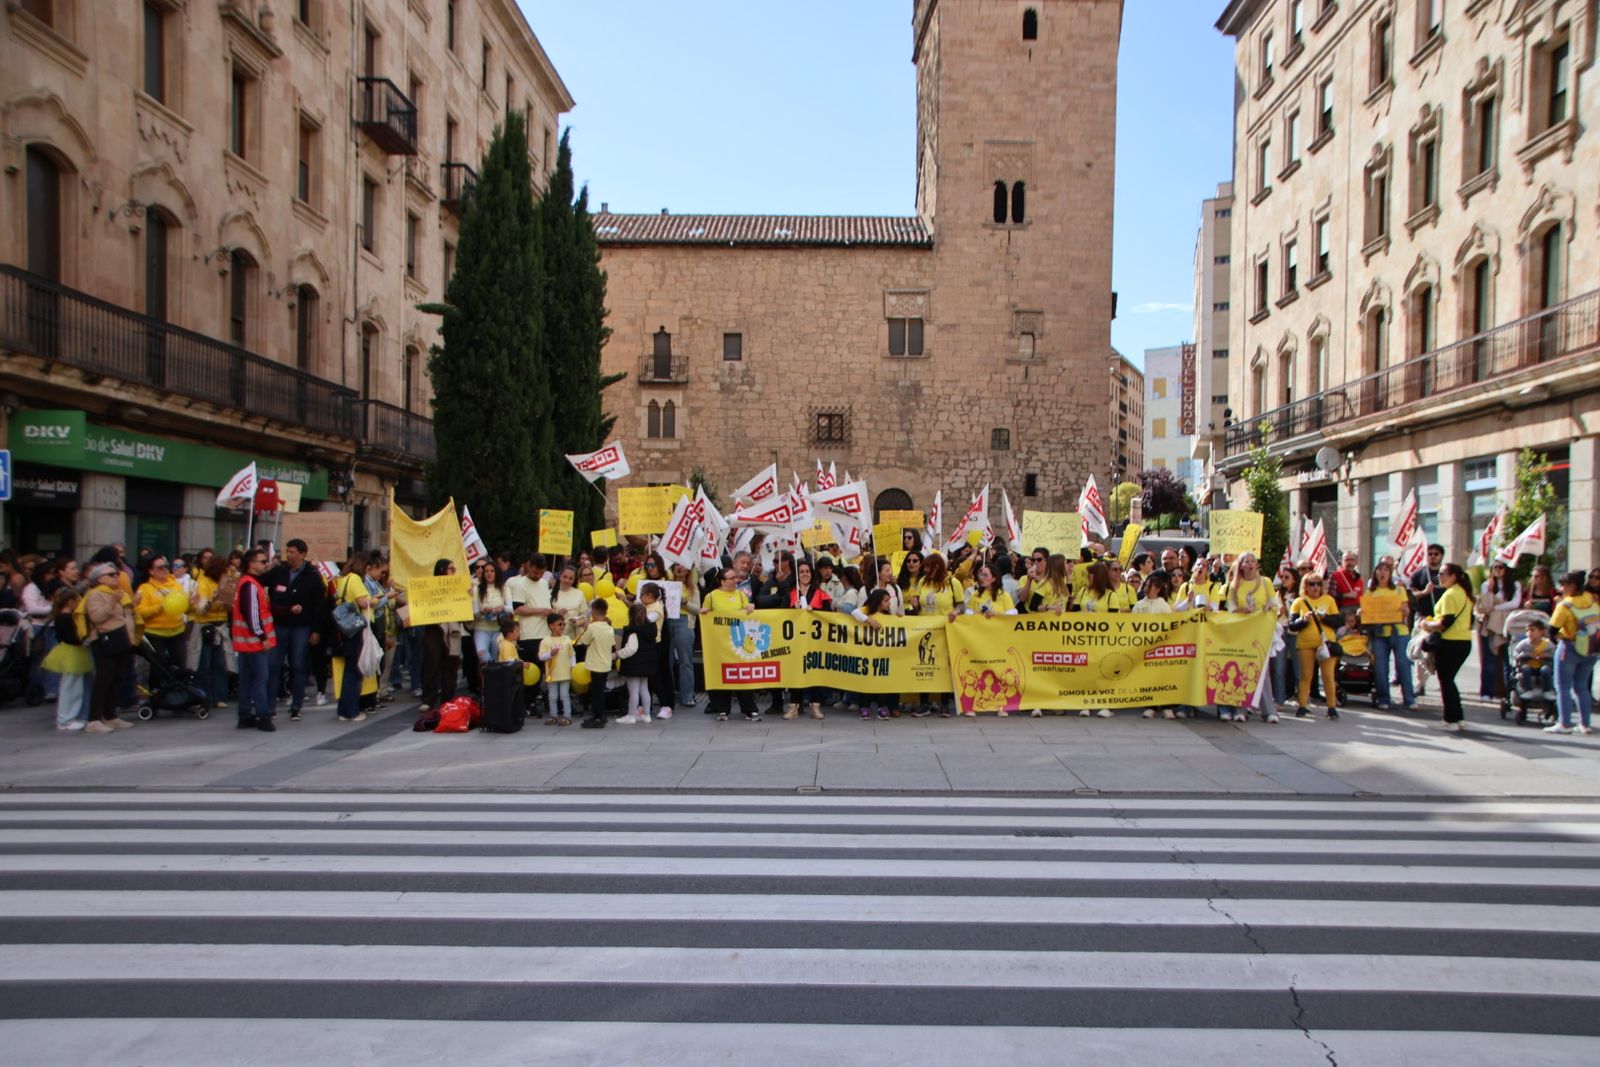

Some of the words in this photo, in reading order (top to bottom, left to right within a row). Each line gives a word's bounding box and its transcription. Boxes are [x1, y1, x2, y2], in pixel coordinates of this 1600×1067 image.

[24, 425, 71, 438] DKV
[111, 438, 135, 457] Salud
[136, 443, 165, 461] DKV
[57, 480, 78, 493] DKV
[669, 504, 698, 552] CCOO
[714, 617, 740, 626] MALTRATO
[1014, 621, 1109, 632] ABANDONO
[1116, 622, 1125, 632] Y
[782, 619, 794, 640] 0
[811, 619, 822, 640] 3
[828, 624, 848, 643] EN
[854, 626, 907, 647] LUCHA
[761, 646, 791, 660] SOLUCIONES
[1146, 646, 1184, 658] CCOO
[803, 651, 869, 676] ¡SOLUCIONES
[872, 657, 890, 676] YA!
[1033, 653, 1072, 664] CCOO
[1144, 659, 1188, 668] enseñanza
[726, 665, 777, 680] CCOO
[1033, 664, 1076, 673] enseñanza
[1139, 685, 1178, 693] INFANCIA
[1109, 695, 1153, 704] EDUCACIÓN
